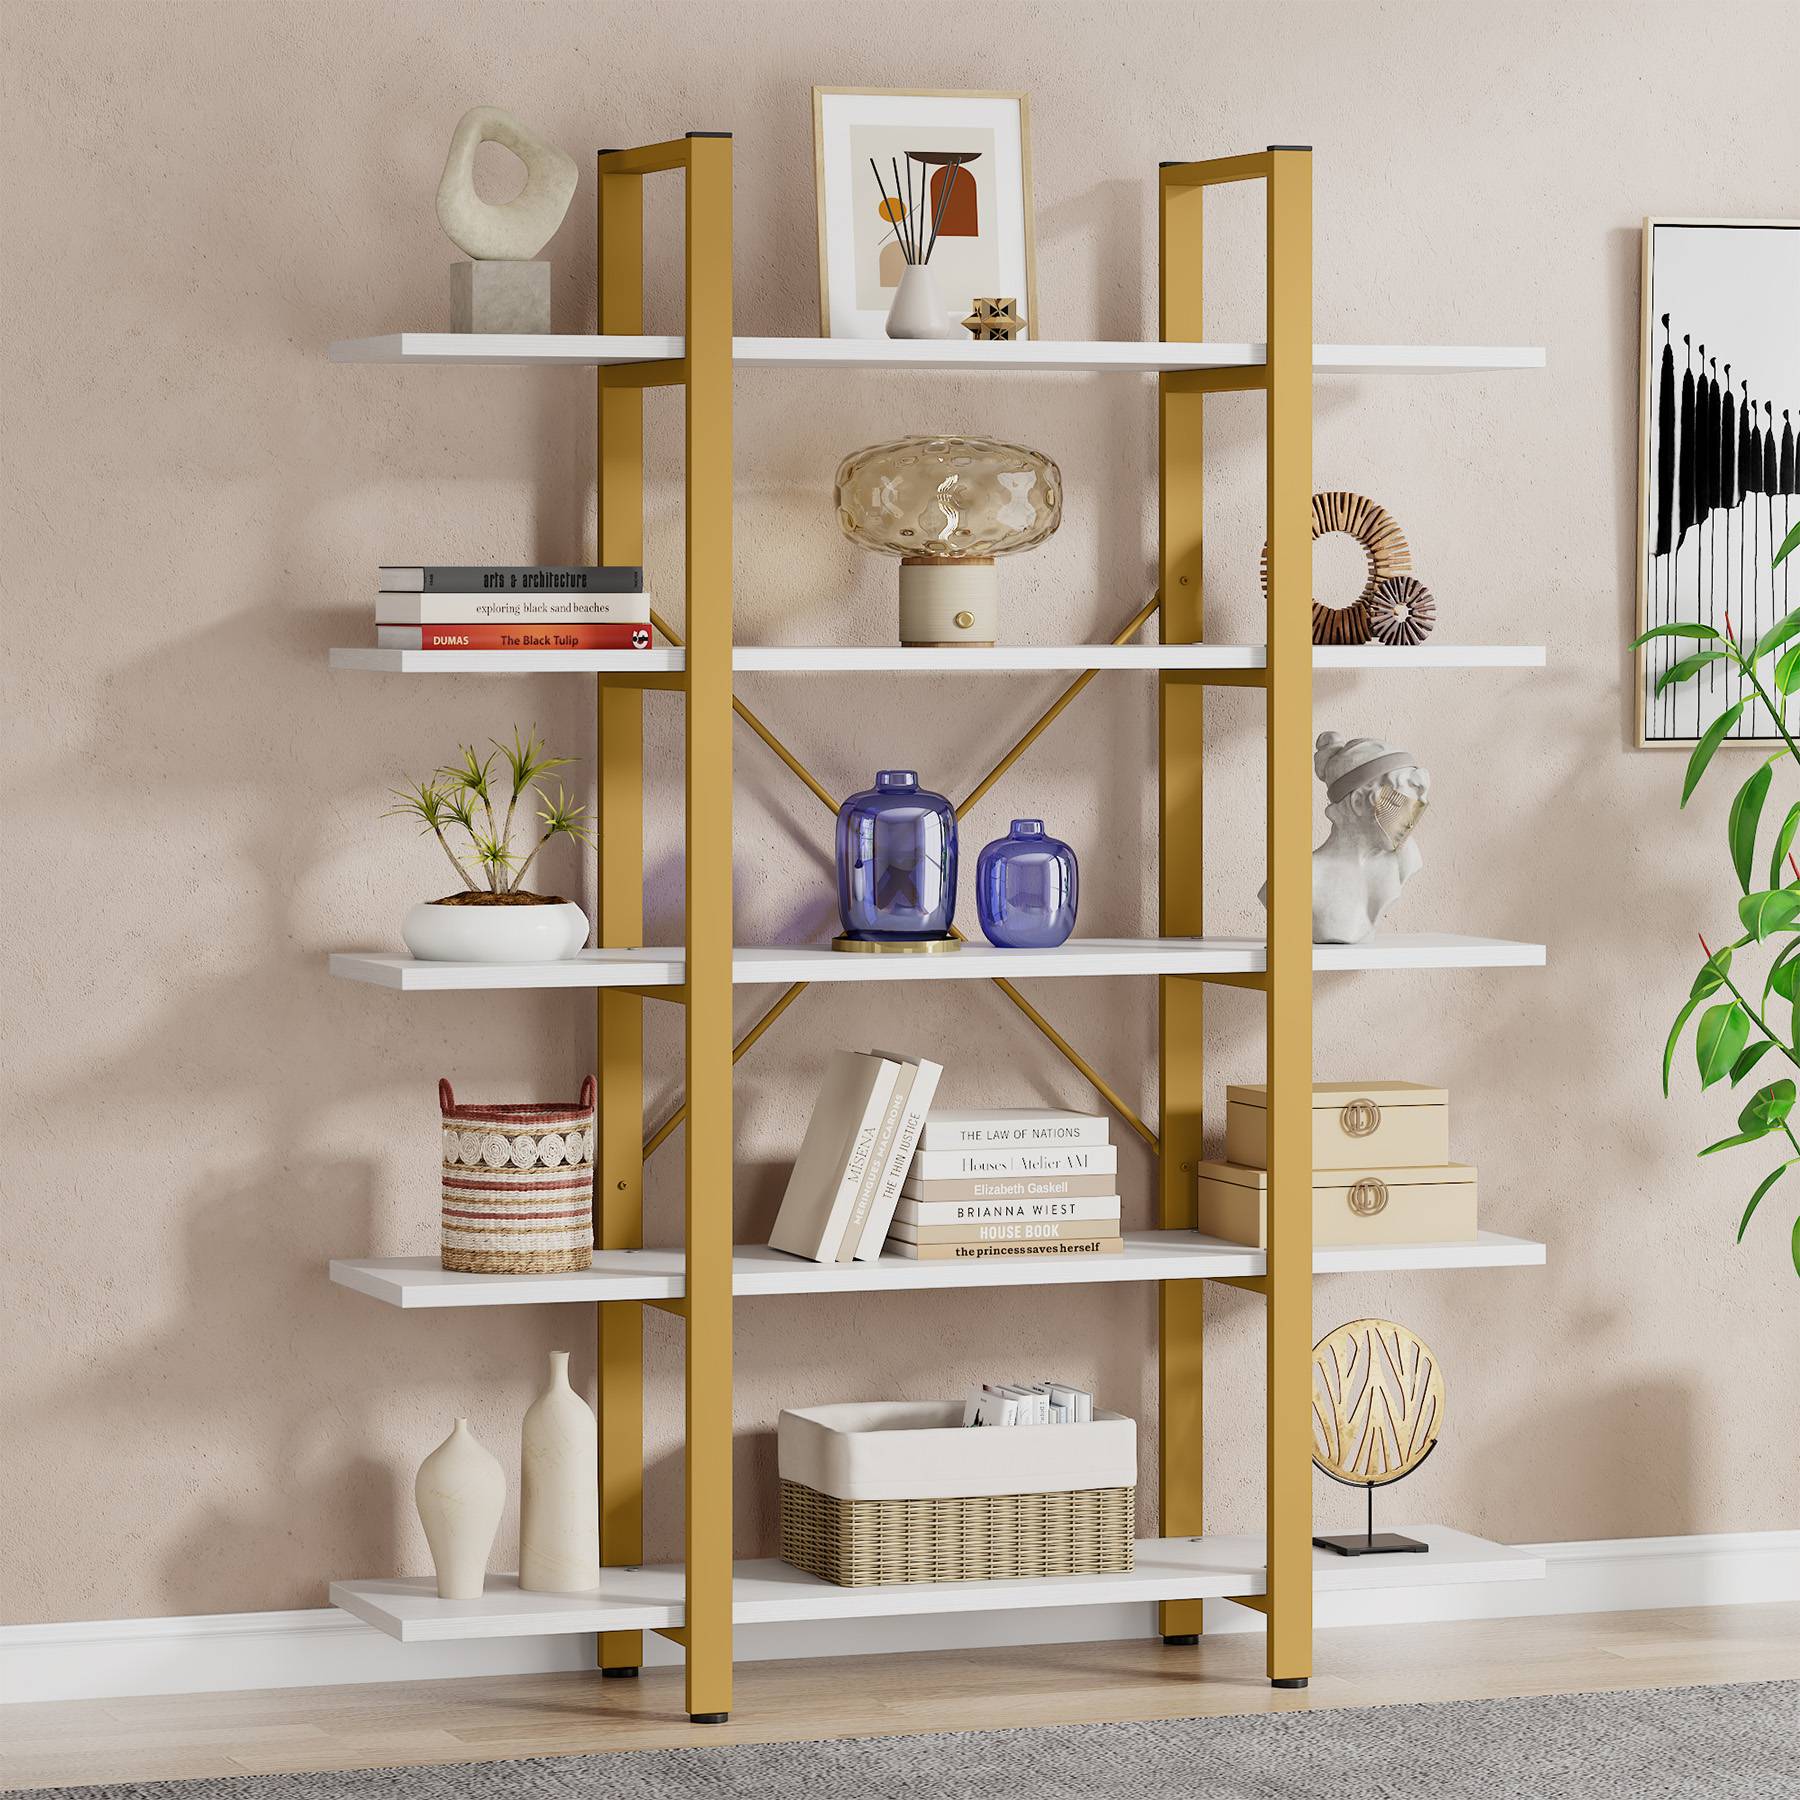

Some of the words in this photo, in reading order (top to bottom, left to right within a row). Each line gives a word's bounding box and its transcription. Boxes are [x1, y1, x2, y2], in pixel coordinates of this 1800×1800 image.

[483, 573, 505, 588] arts
[510, 573, 518, 588] &
[522, 572, 588, 588] architecture
[476, 603, 521, 616] exploring
[523, 602, 548, 613] black
[550, 602, 572, 613] sand
[573, 602, 610, 613] beaches
[433, 635, 469, 645] DUMAS
[501, 635, 521, 646] The
[523, 635, 551, 646] Black
[553, 635, 579, 648] Tulip
[960, 1130, 983, 1141] THE
[986, 1129, 1010, 1140] LAW
[1013, 1129, 1028, 1140] OF
[1032, 1128, 1081, 1139] NATIONS
[853, 1160, 881, 1225] MERINGUES
[878, 1094, 904, 1158] MACARONS
[882, 1181, 898, 1199] THE
[890, 1155, 906, 1178] THIN
[900, 1112, 921, 1155] JUSTICE
[1021, 1156, 1061, 1170] Atelier
[974, 1183, 1025, 1196] Elizabeth
[1027, 1182, 1068, 1195] Gaskell
[957, 1205, 1025, 1218] BRIANNA
[1032, 1203, 1076, 1216] WIEST
[980, 1225, 1021, 1240] HOUSE
[1025, 1224, 1060, 1238] BOOK
[955, 1247, 975, 1257] the
[977, 1245, 1026, 1258] princess
[1026, 1245, 1059, 1255] saves
[1060, 1242, 1101, 1253] herself
